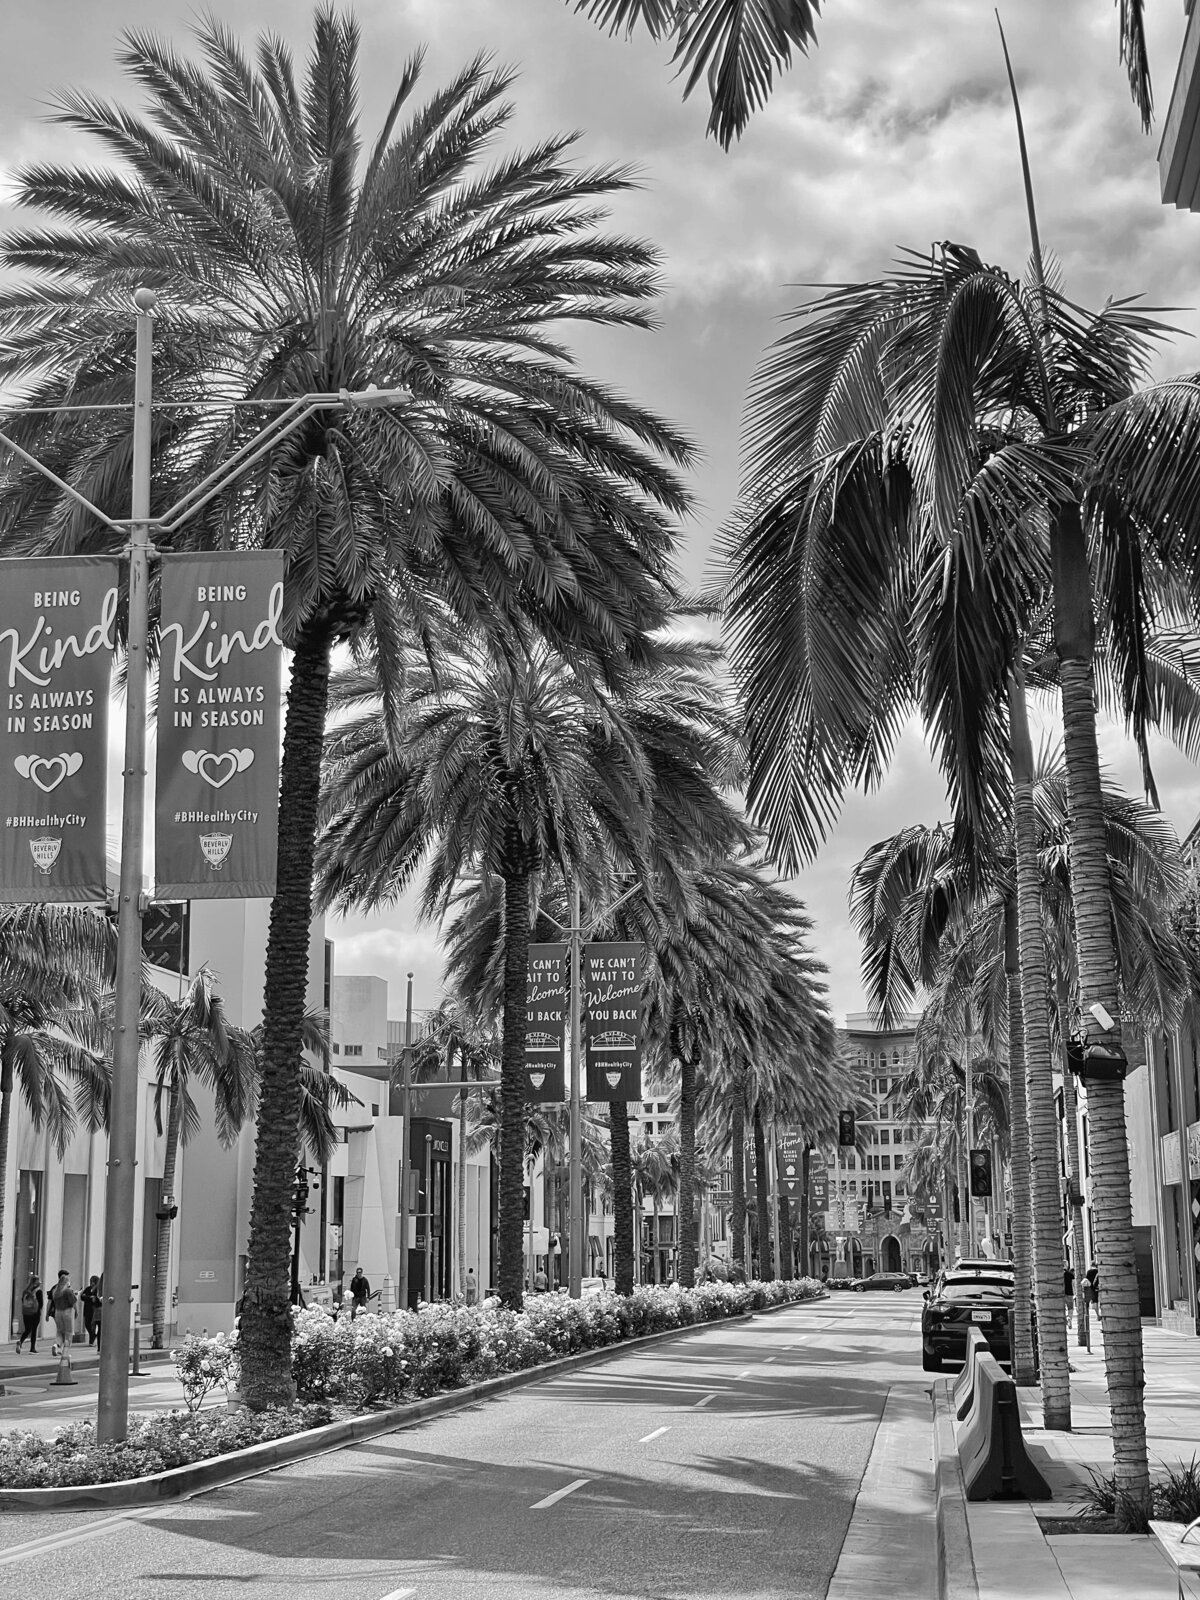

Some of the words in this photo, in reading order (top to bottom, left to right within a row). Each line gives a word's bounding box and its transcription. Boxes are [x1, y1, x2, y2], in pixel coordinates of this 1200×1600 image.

[34, 590, 81, 608] BEING
[197, 585, 247, 602] BEING
[0, 587, 118, 688] Kind
[160, 581, 284, 682] Kind
[8, 693, 24, 710] IS
[30, 689, 94, 709] ALWAYS
[174, 687, 189, 704] IS
[197, 686, 265, 704] ALWAYS
[7, 717, 26, 733] IN
[33, 713, 93, 732] SEASON
[174, 711, 192, 728] IN
[201, 709, 264, 727] SEASON
[6, 814, 87, 828] #BHHealthyCity
[174, 810, 258, 824] #BHHealthyCity
[33, 844, 57, 852] BEVERLY
[203, 840, 229, 848] BEVERLY
[36, 852, 54, 860] HILLS
[207, 848, 225, 856] HILLS
[532, 959, 561, 970] CAN'T
[590, 958, 605, 969] WE
[607, 957, 636, 968] CAN'T
[526, 972, 542, 983] AIT
[547, 972, 560, 982] TO
[591, 971, 617, 981] WAIT
[622, 971, 635, 981] TO
[526, 985, 566, 1004] elcome
[585, 984, 641, 1008] Welcome
[537, 1011, 562, 1021] BACK
[589, 1010, 609, 1020] YOU
[613, 1009, 637, 1020] BACK
[777, 1137, 802, 1150] Home
